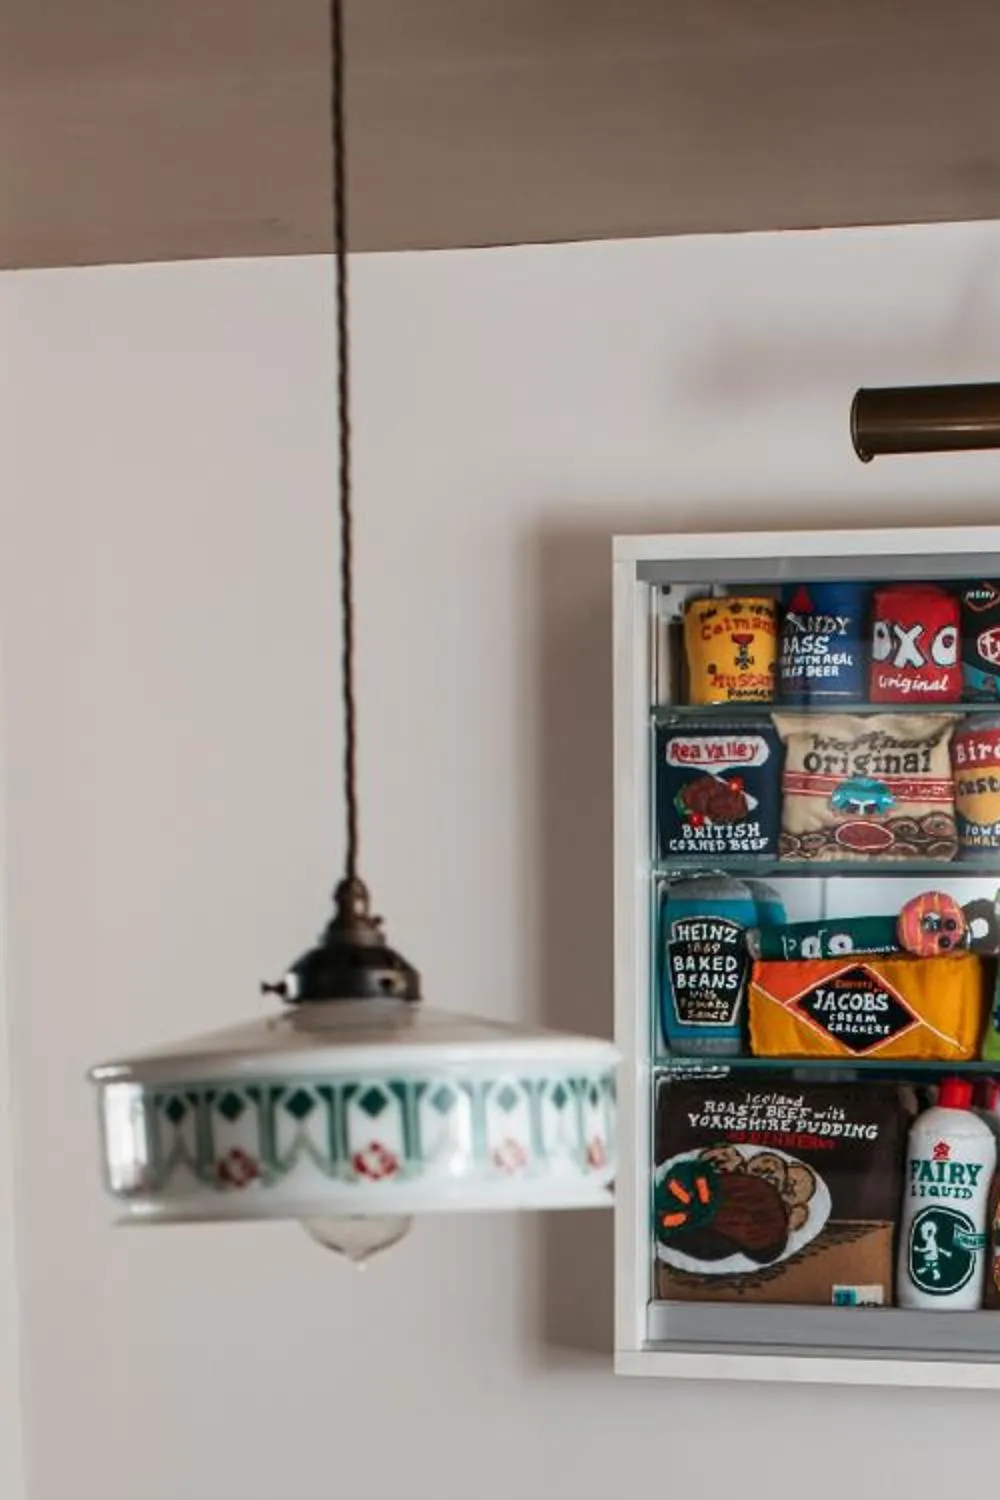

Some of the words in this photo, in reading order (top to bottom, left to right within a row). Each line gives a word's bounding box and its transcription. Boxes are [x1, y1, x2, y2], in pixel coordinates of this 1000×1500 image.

[872, 620, 959, 670] OXO
[878, 674, 949, 695] Original
[681, 822, 761, 840] BRITISH
[729, 837, 769, 852] BEEF
[676, 923, 740, 943] HEINZ
[672, 954, 738, 972] BAKED
[676, 972, 740, 989] BEANS
[746, 1092, 805, 1108] Iceland
[703, 1100, 760, 1118] ROAST
[765, 1104, 813, 1121] BEEF
[813, 1105, 846, 1121] with
[687, 1112, 792, 1133] YORKSHIRE
[795, 1118, 880, 1140] PUDDING
[909, 1159, 985, 1187] FAIRY
[911, 1184, 974, 1200] LIQUID
